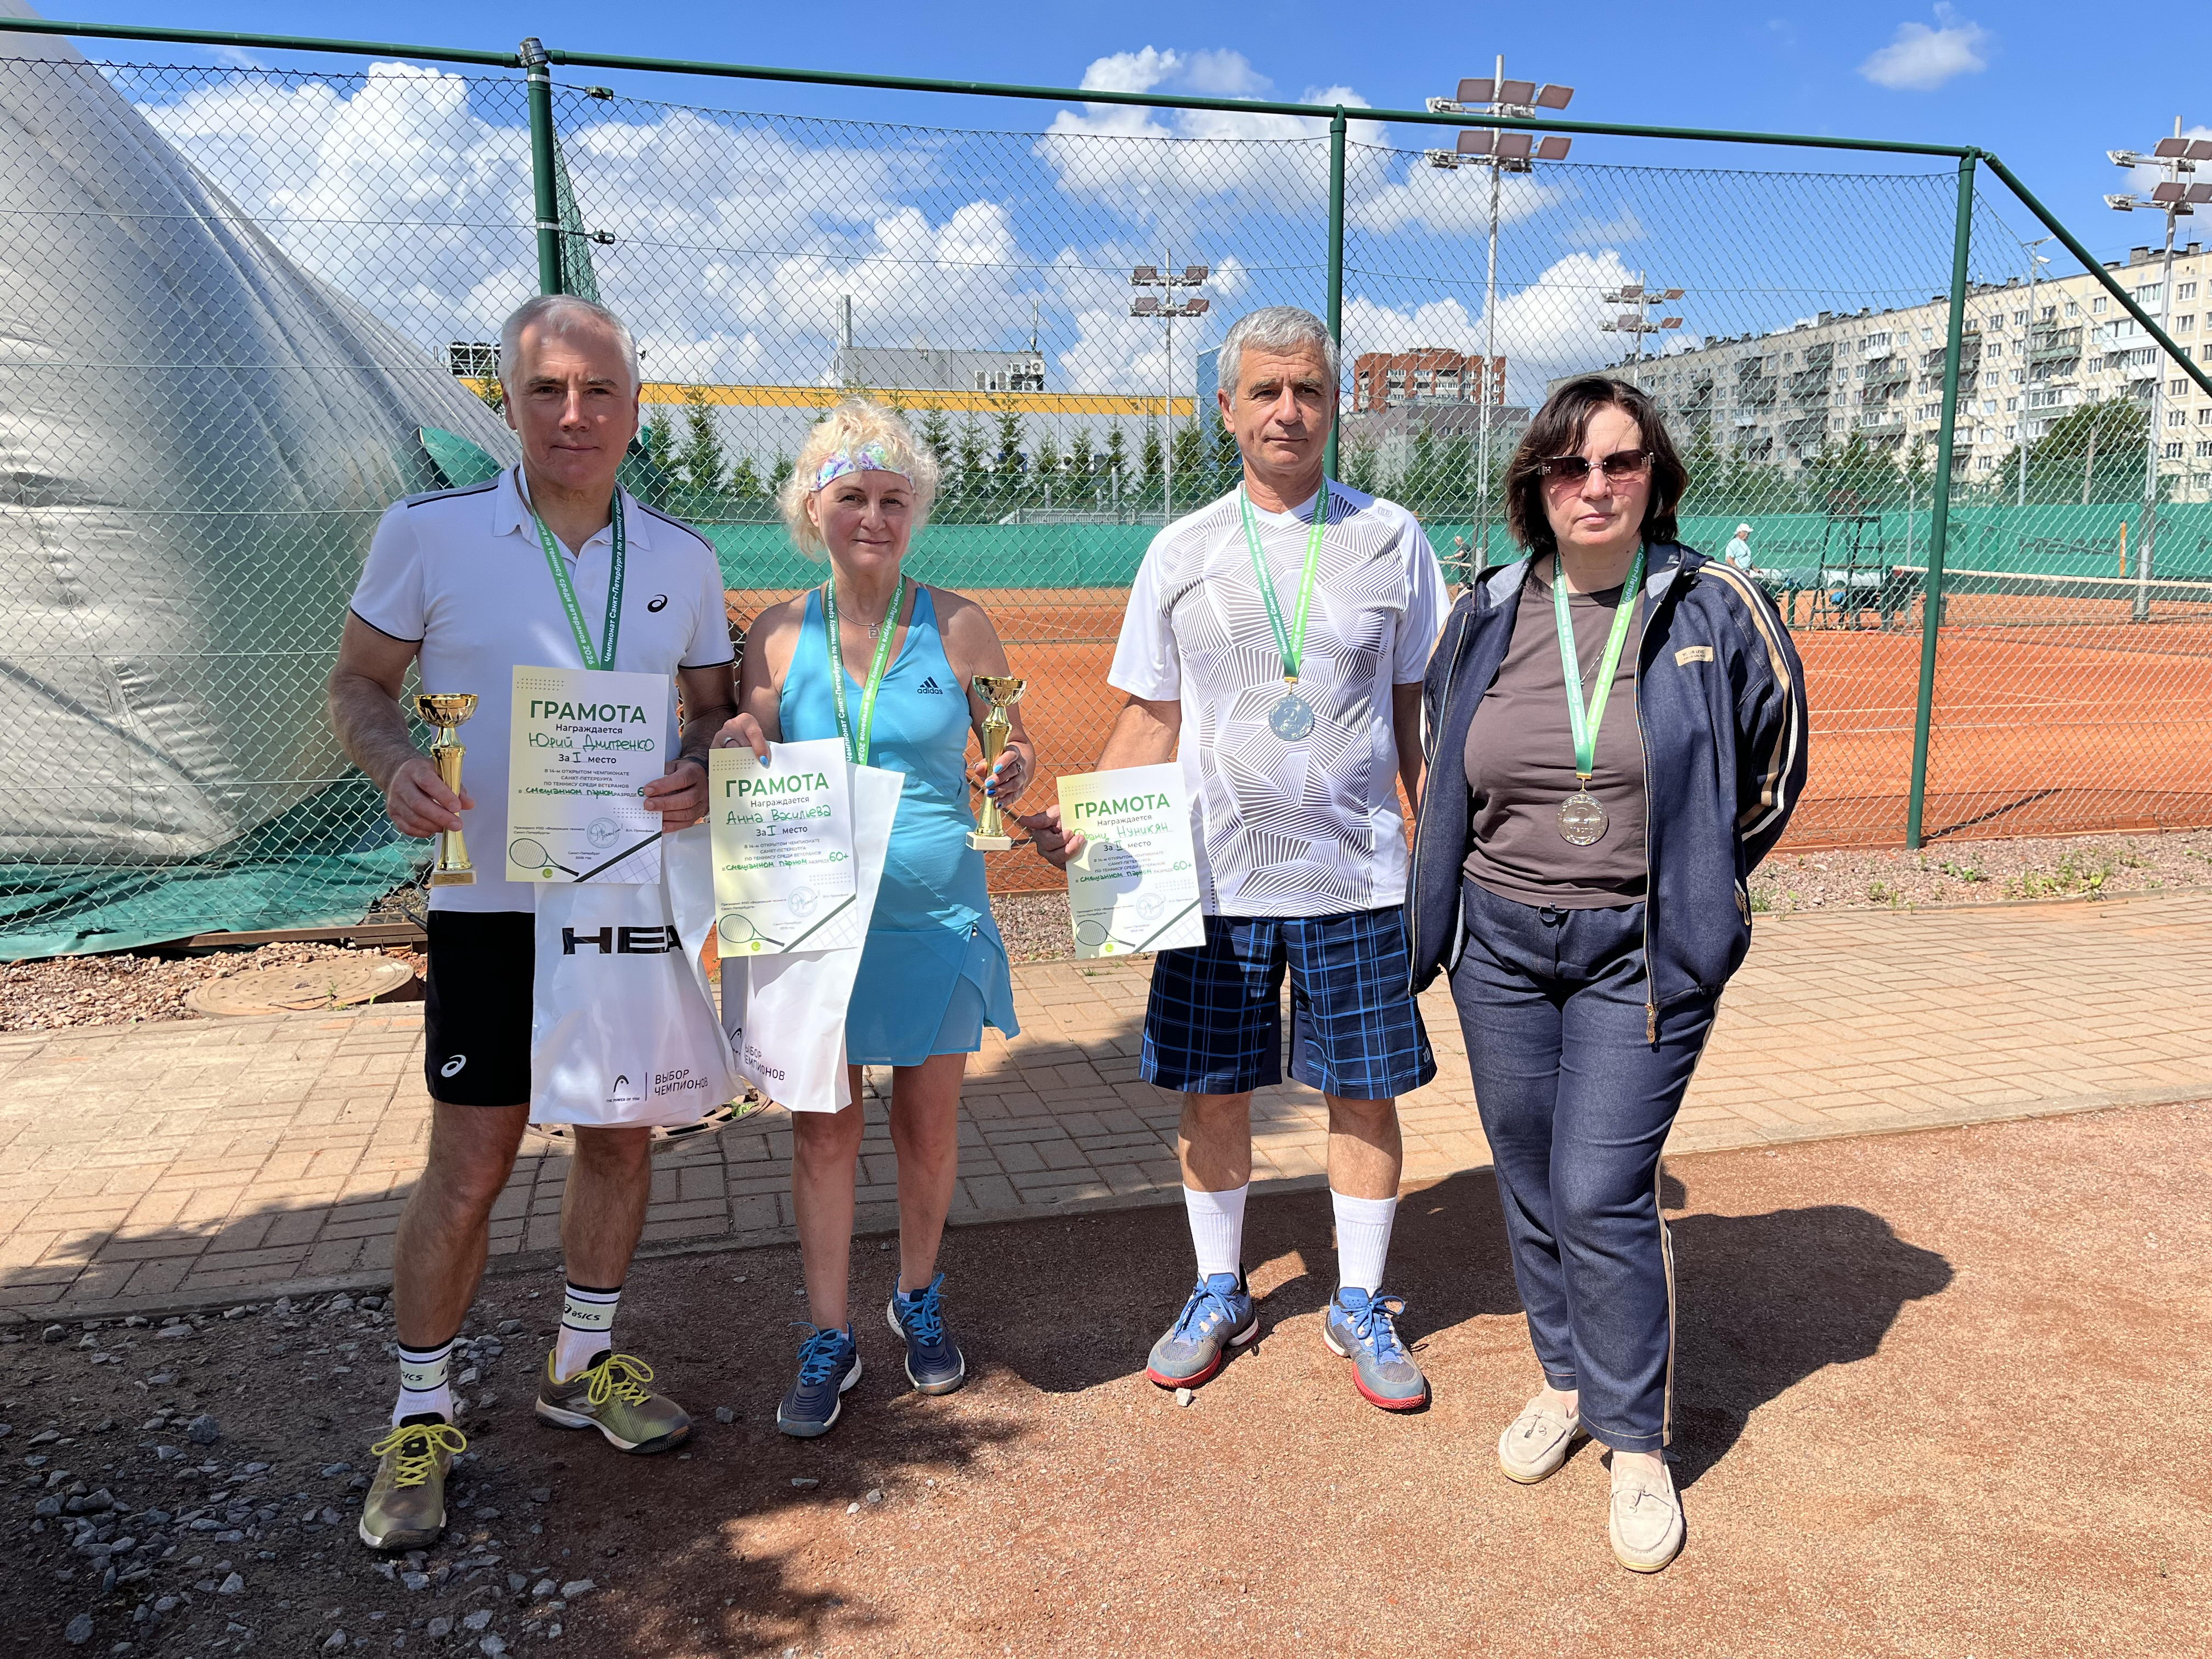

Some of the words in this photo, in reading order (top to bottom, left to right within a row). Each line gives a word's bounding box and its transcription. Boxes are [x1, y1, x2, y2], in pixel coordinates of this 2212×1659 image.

[617, 541, 623, 551] по
[1758, 540, 1821, 553] HEAD
[2019, 538, 2118, 554] HEAD
[609, 551, 623, 618] Санкт-Петербурга
[544, 537, 552, 546] по
[548, 548, 563, 578] теннису
[559, 579, 572, 602] среди
[568, 603, 586, 644] ветеранов
[583, 645, 595, 665] 2026
[882, 588, 902, 643] Санкт-Петербурга
[604, 619, 616, 662] Чемпионат
[1273, 616, 1288, 654] Чемпионат
[1292, 634, 1301, 652] 2026
[832, 646, 837, 654] по
[879, 643, 886, 652] по
[832, 655, 845, 719] Санкт-Петербурга
[530, 700, 647, 724] ГРАМОТА
[556, 724, 623, 734] Награждается
[529, 732, 573, 748] Юрий
[583, 734, 655, 752] Дмитренко
[558, 754, 570, 762] За
[588, 755, 617, 764] место
[726, 772, 830, 797] ГРАМОТА
[586, 789, 613, 799] парном
[751, 797, 809, 808] Награждается
[1074, 793, 1170, 819] ГРАМОТА
[727, 810, 763, 825] Анна
[771, 805, 831, 821] Васильева
[1097, 815, 1152, 826] Награждается
[782, 826, 808, 834] место
[1117, 822, 1169, 838] Нуникян
[779, 859, 808, 870] парном
[829, 851, 849, 862] 60+
[1126, 869, 1153, 878] парном
[1173, 861, 1192, 871] 60+
[562, 925, 684, 955] HEA
[746, 1045, 762, 1059] ЫБОР
[745, 1054, 785, 1081] ЕМПИОНОВ
[655, 1069, 690, 1085] ВЫБОР
[654, 1077, 709, 1096] ЧЕМПИОНОВ
[572, 1311, 602, 1321] asics
[402, 1371, 424, 1381] ics
